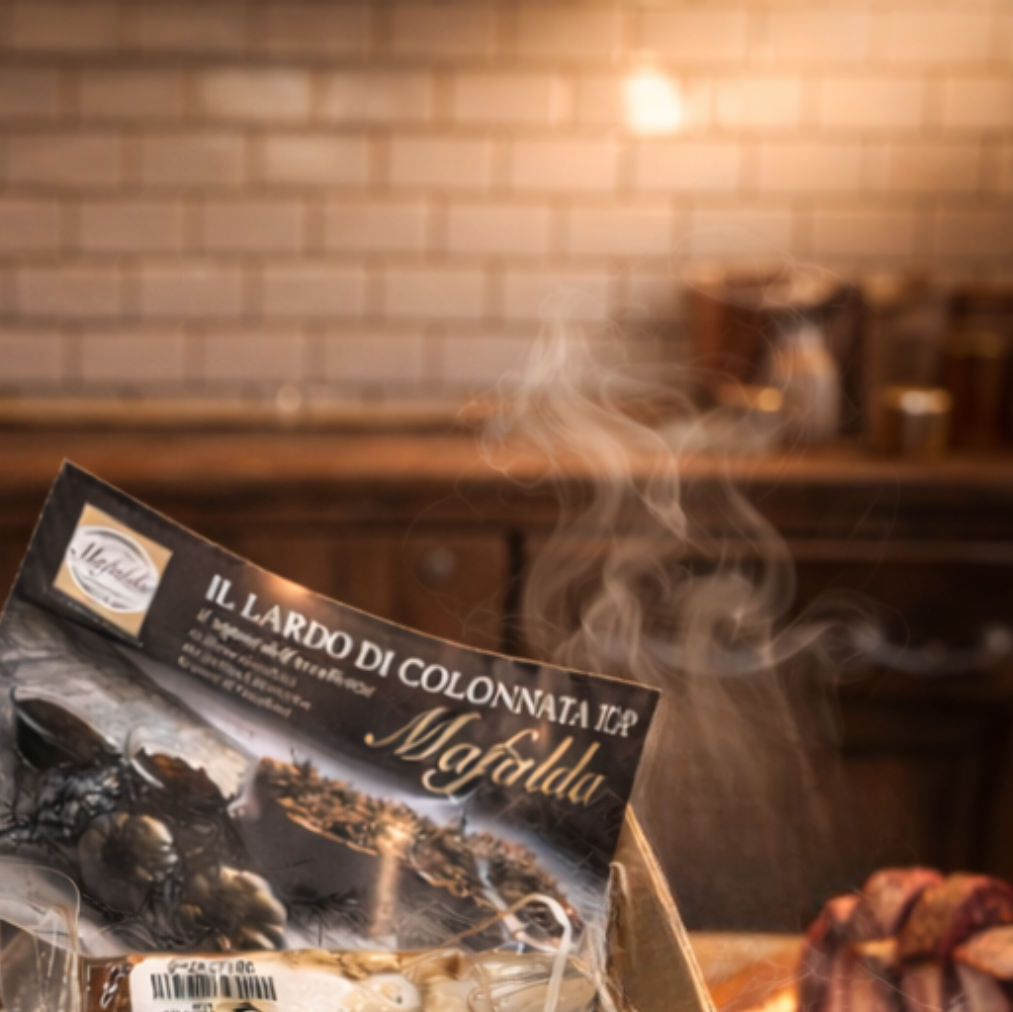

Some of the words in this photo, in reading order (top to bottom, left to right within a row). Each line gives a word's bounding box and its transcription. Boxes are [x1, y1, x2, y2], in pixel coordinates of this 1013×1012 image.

[205, 573, 235, 611] IL
[240, 592, 353, 660] LARDO
[354, 641, 396, 678] DI
[398, 657, 589, 729] COLONNATA
[364, 705, 607, 804] Mafalda
